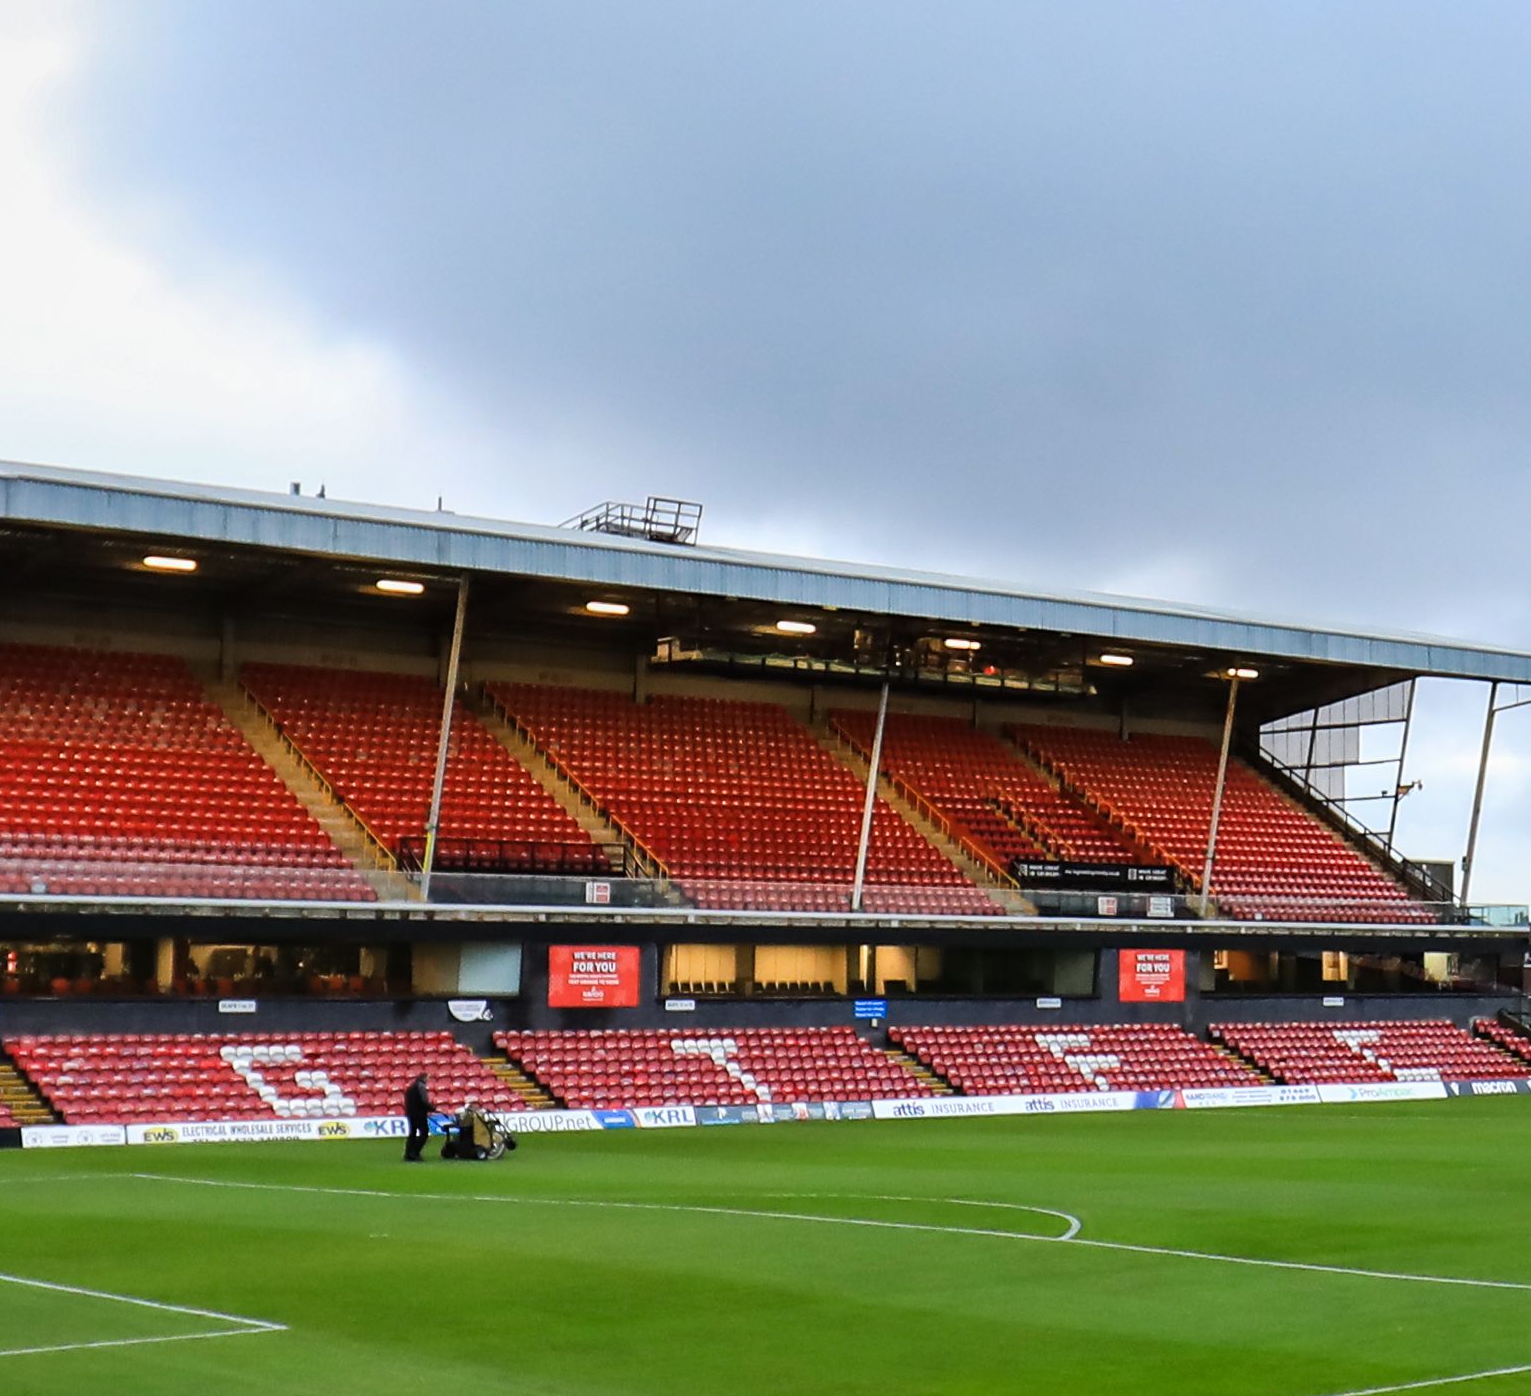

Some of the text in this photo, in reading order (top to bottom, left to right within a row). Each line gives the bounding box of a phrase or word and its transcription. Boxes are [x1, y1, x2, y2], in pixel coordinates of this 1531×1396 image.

[597, 951, 616, 961] HERE
[572, 962, 616, 973] FOR YOU
[1136, 963, 1170, 973] FOR YOU
[1471, 1081, 1517, 1095] macron
[931, 1101, 995, 1115] INSURANCE
[1060, 1097, 1119, 1109] INSURANCE
[651, 1108, 695, 1125] KRL
[142, 1127, 175, 1143] EWS
[182, 1121, 312, 1138] ELECTRICAL WHOLESALE SERVICES
[318, 1122, 347, 1137] EWS
